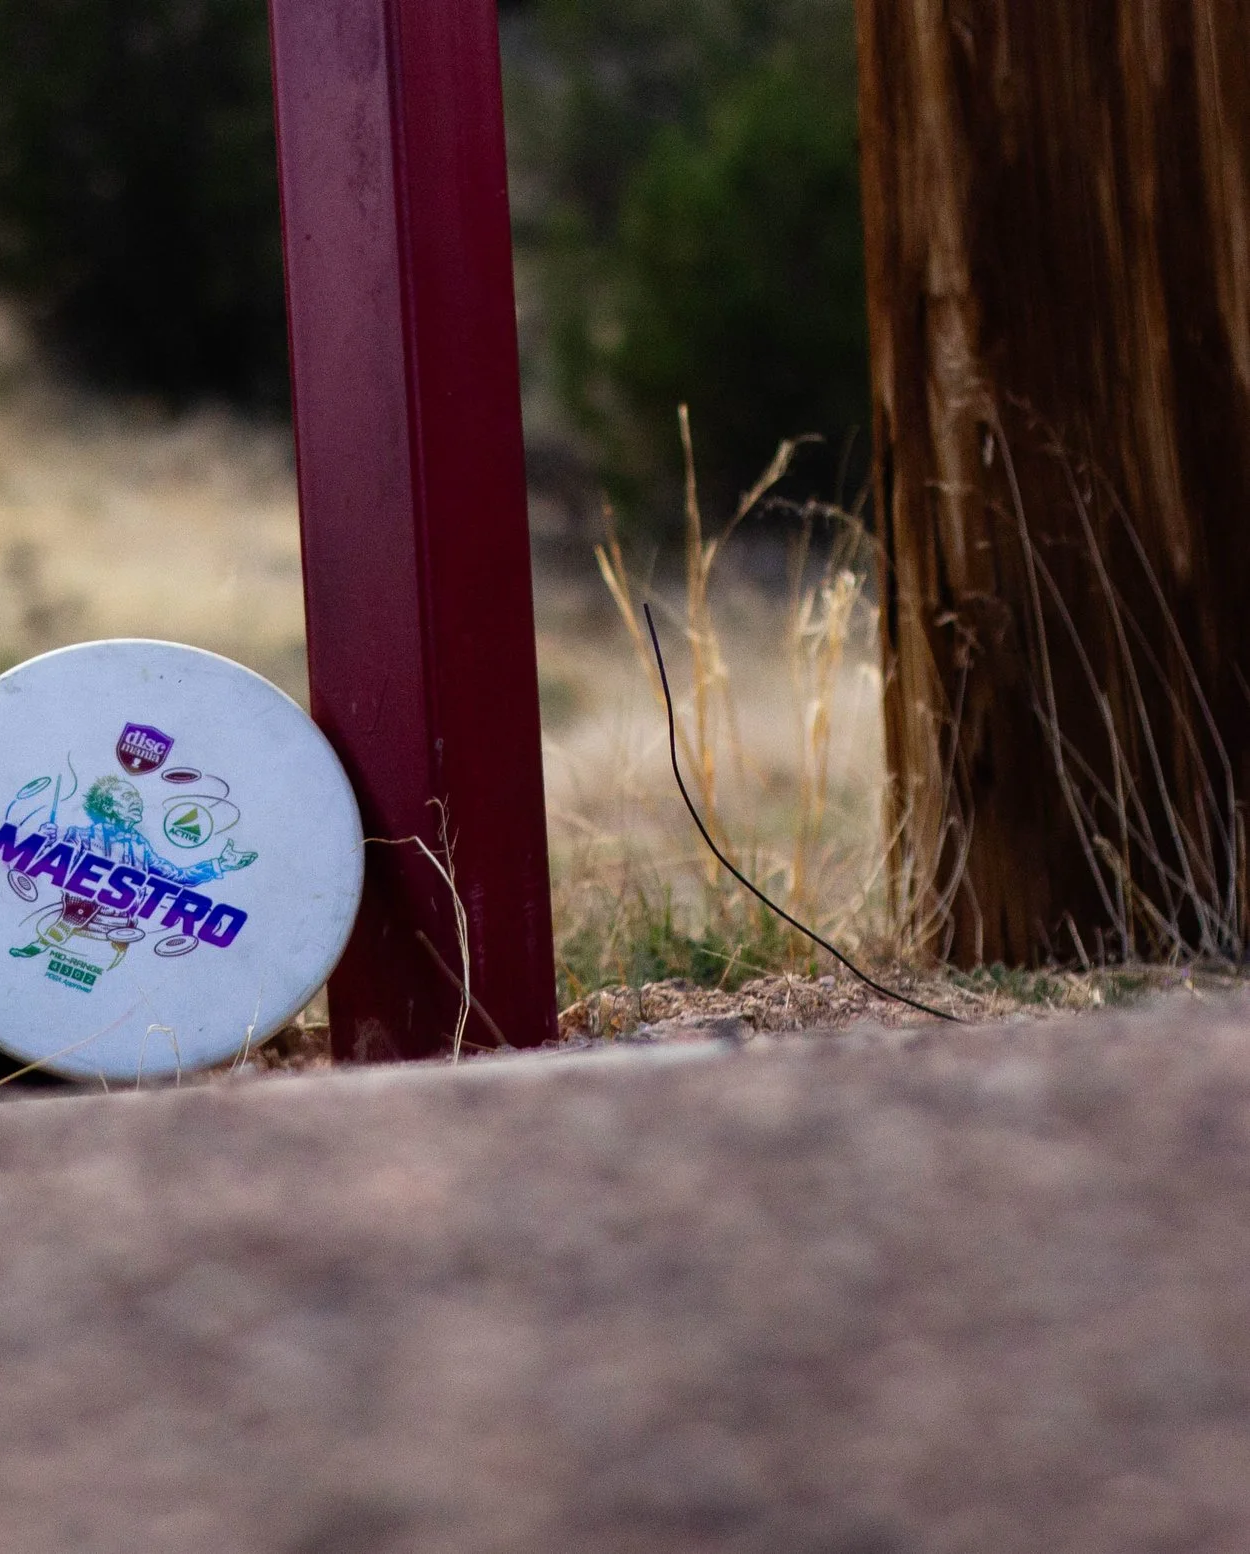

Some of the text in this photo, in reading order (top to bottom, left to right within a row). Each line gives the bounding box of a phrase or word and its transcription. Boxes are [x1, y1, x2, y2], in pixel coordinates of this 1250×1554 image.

[120, 742, 161, 763] mania
[125, 730, 166, 755] disc
[168, 827, 201, 844] ACTIVE
[49, 950, 103, 975] MID-RANGE
